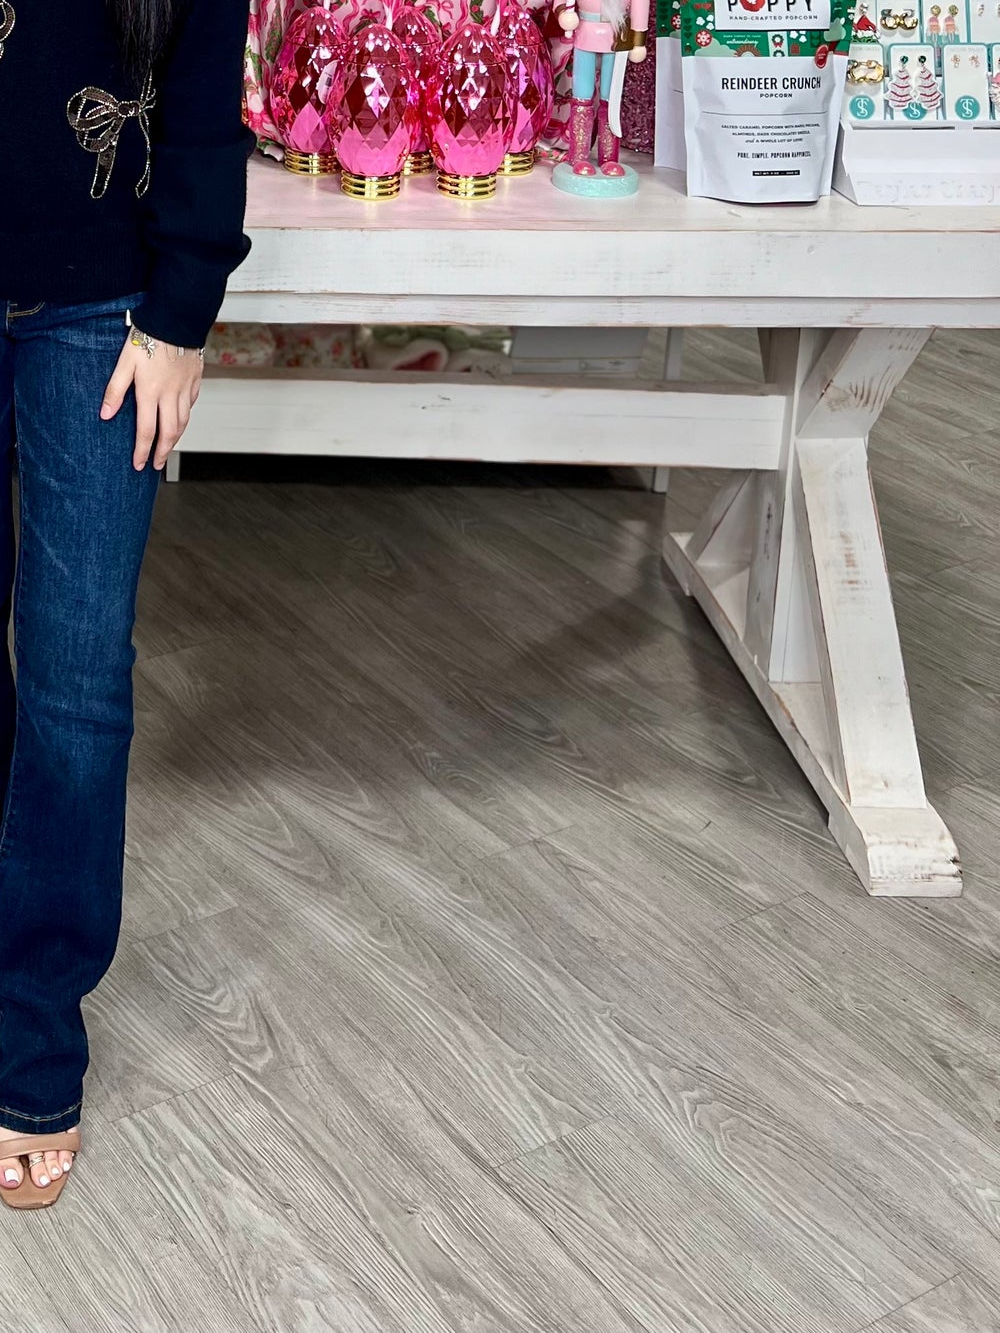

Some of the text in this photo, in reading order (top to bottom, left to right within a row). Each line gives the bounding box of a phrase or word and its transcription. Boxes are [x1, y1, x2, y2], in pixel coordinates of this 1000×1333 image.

[721, 76, 822, 90] REINDEER CRUNCH
[770, 151, 791, 159] POPCORN
